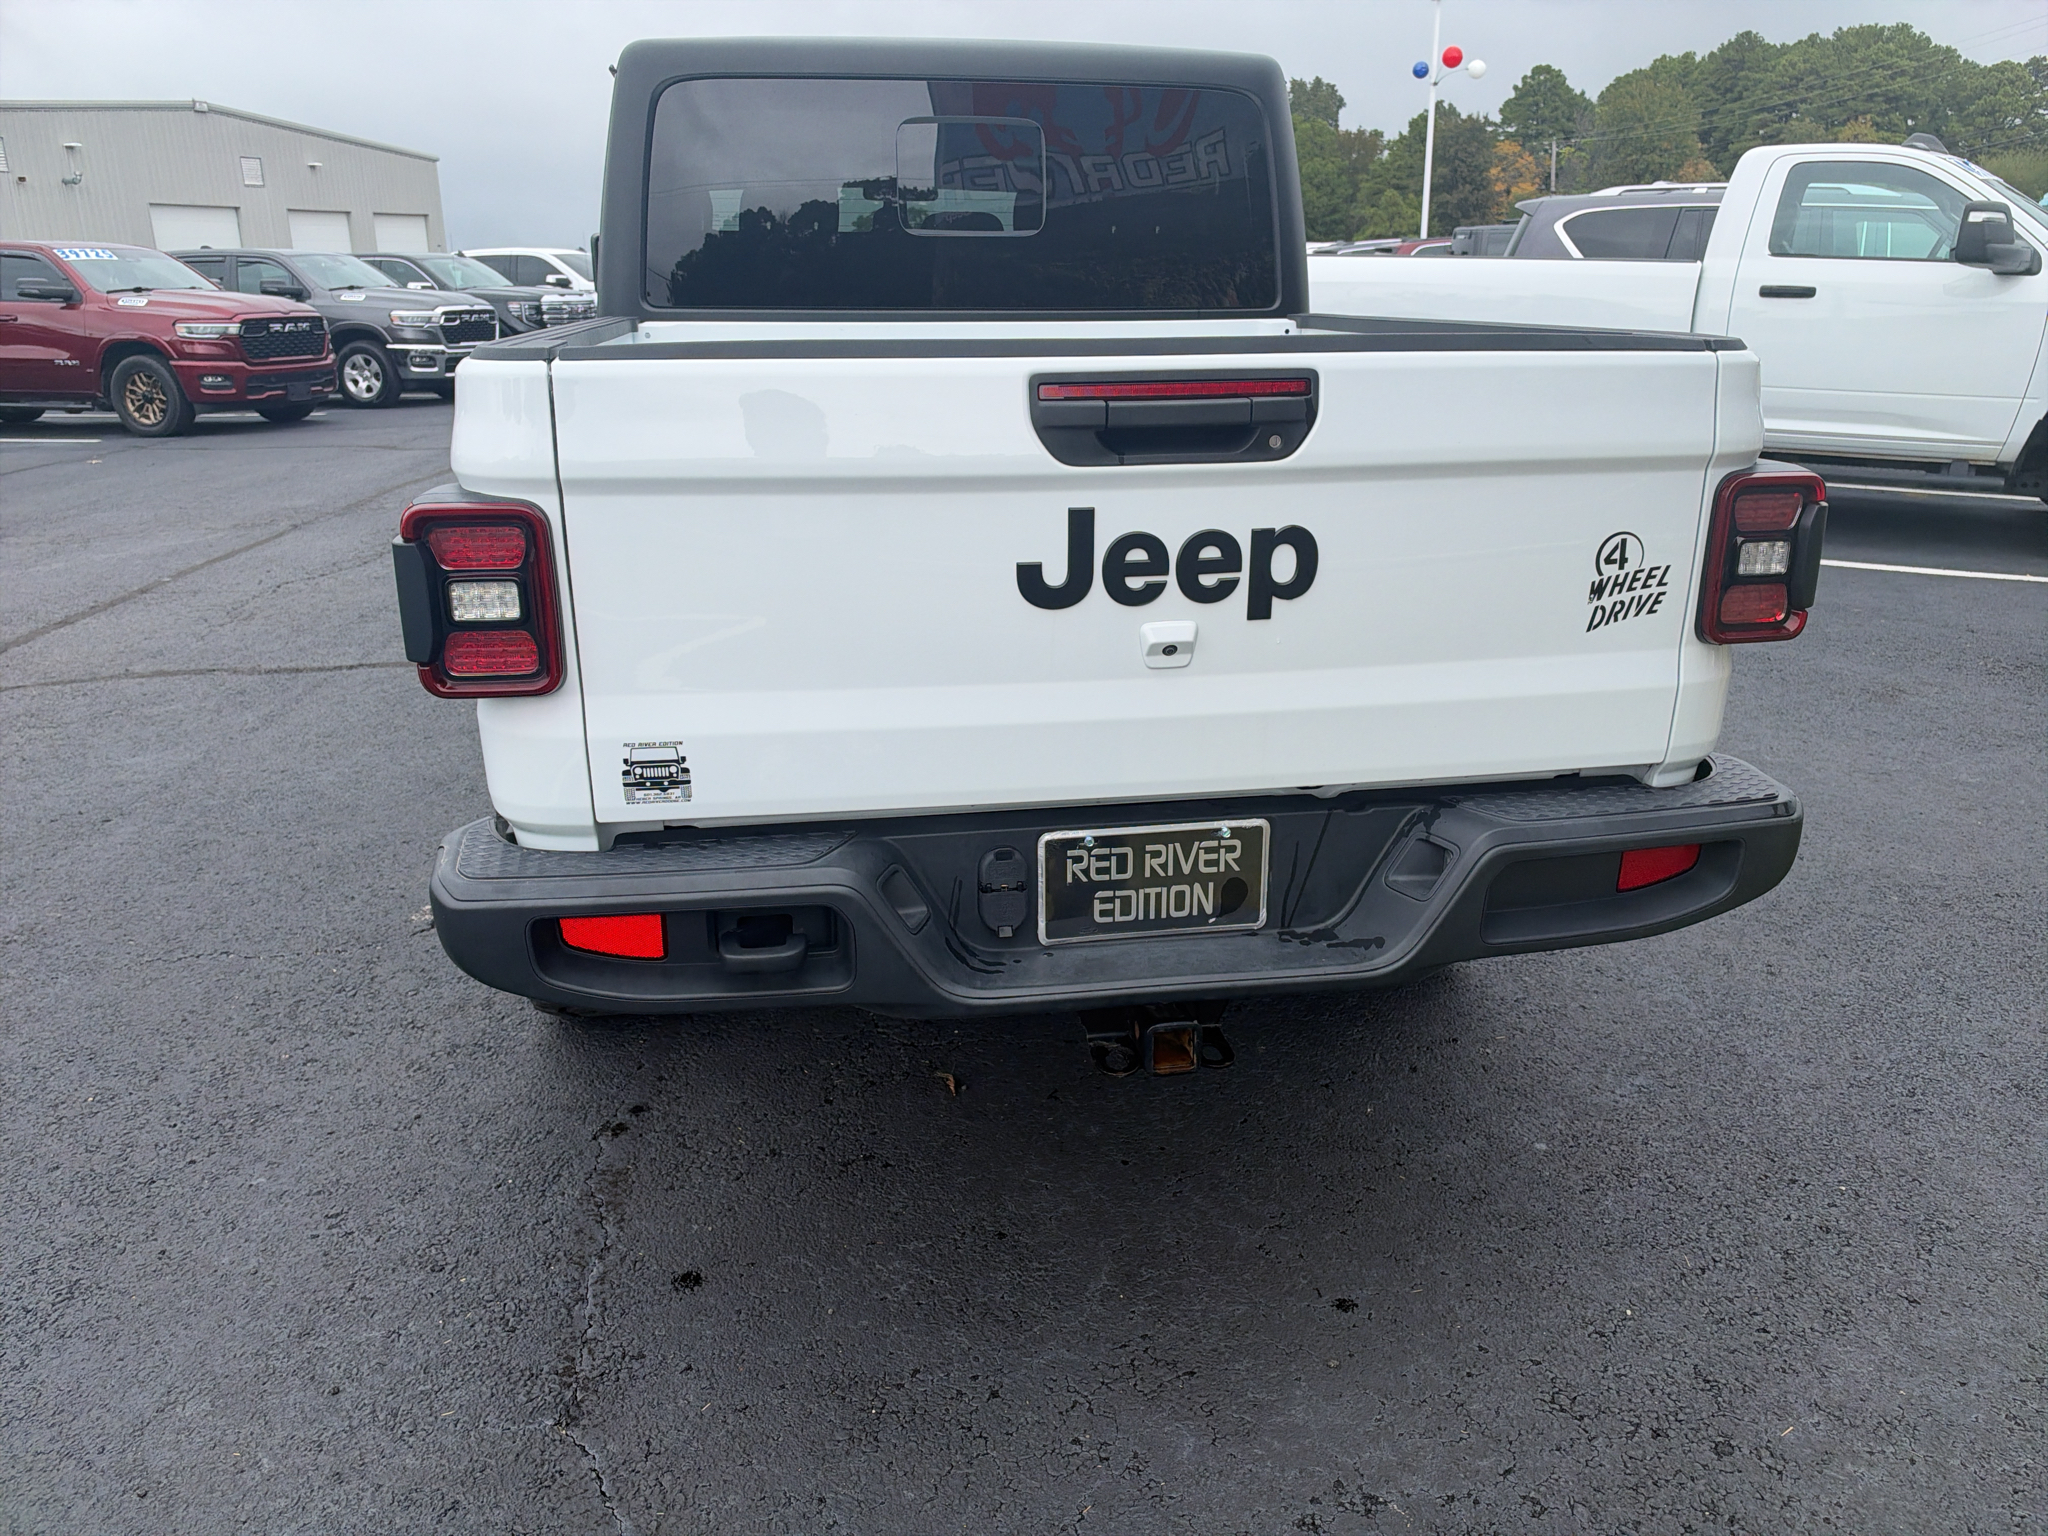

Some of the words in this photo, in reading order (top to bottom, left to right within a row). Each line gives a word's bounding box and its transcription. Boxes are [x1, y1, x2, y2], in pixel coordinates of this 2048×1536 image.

[56, 249, 114, 259] 39725
[268, 322, 311, 333] RAM
[1016, 506, 1319, 621] Jeep
[1603, 537, 1629, 571] 4
[1587, 564, 1672, 603] WHEEL
[1585, 591, 1668, 633] DRIVE
[1066, 847, 1134, 884] RED
[1144, 839, 1242, 878] RIVER
[1093, 881, 1214, 924] EDITION
